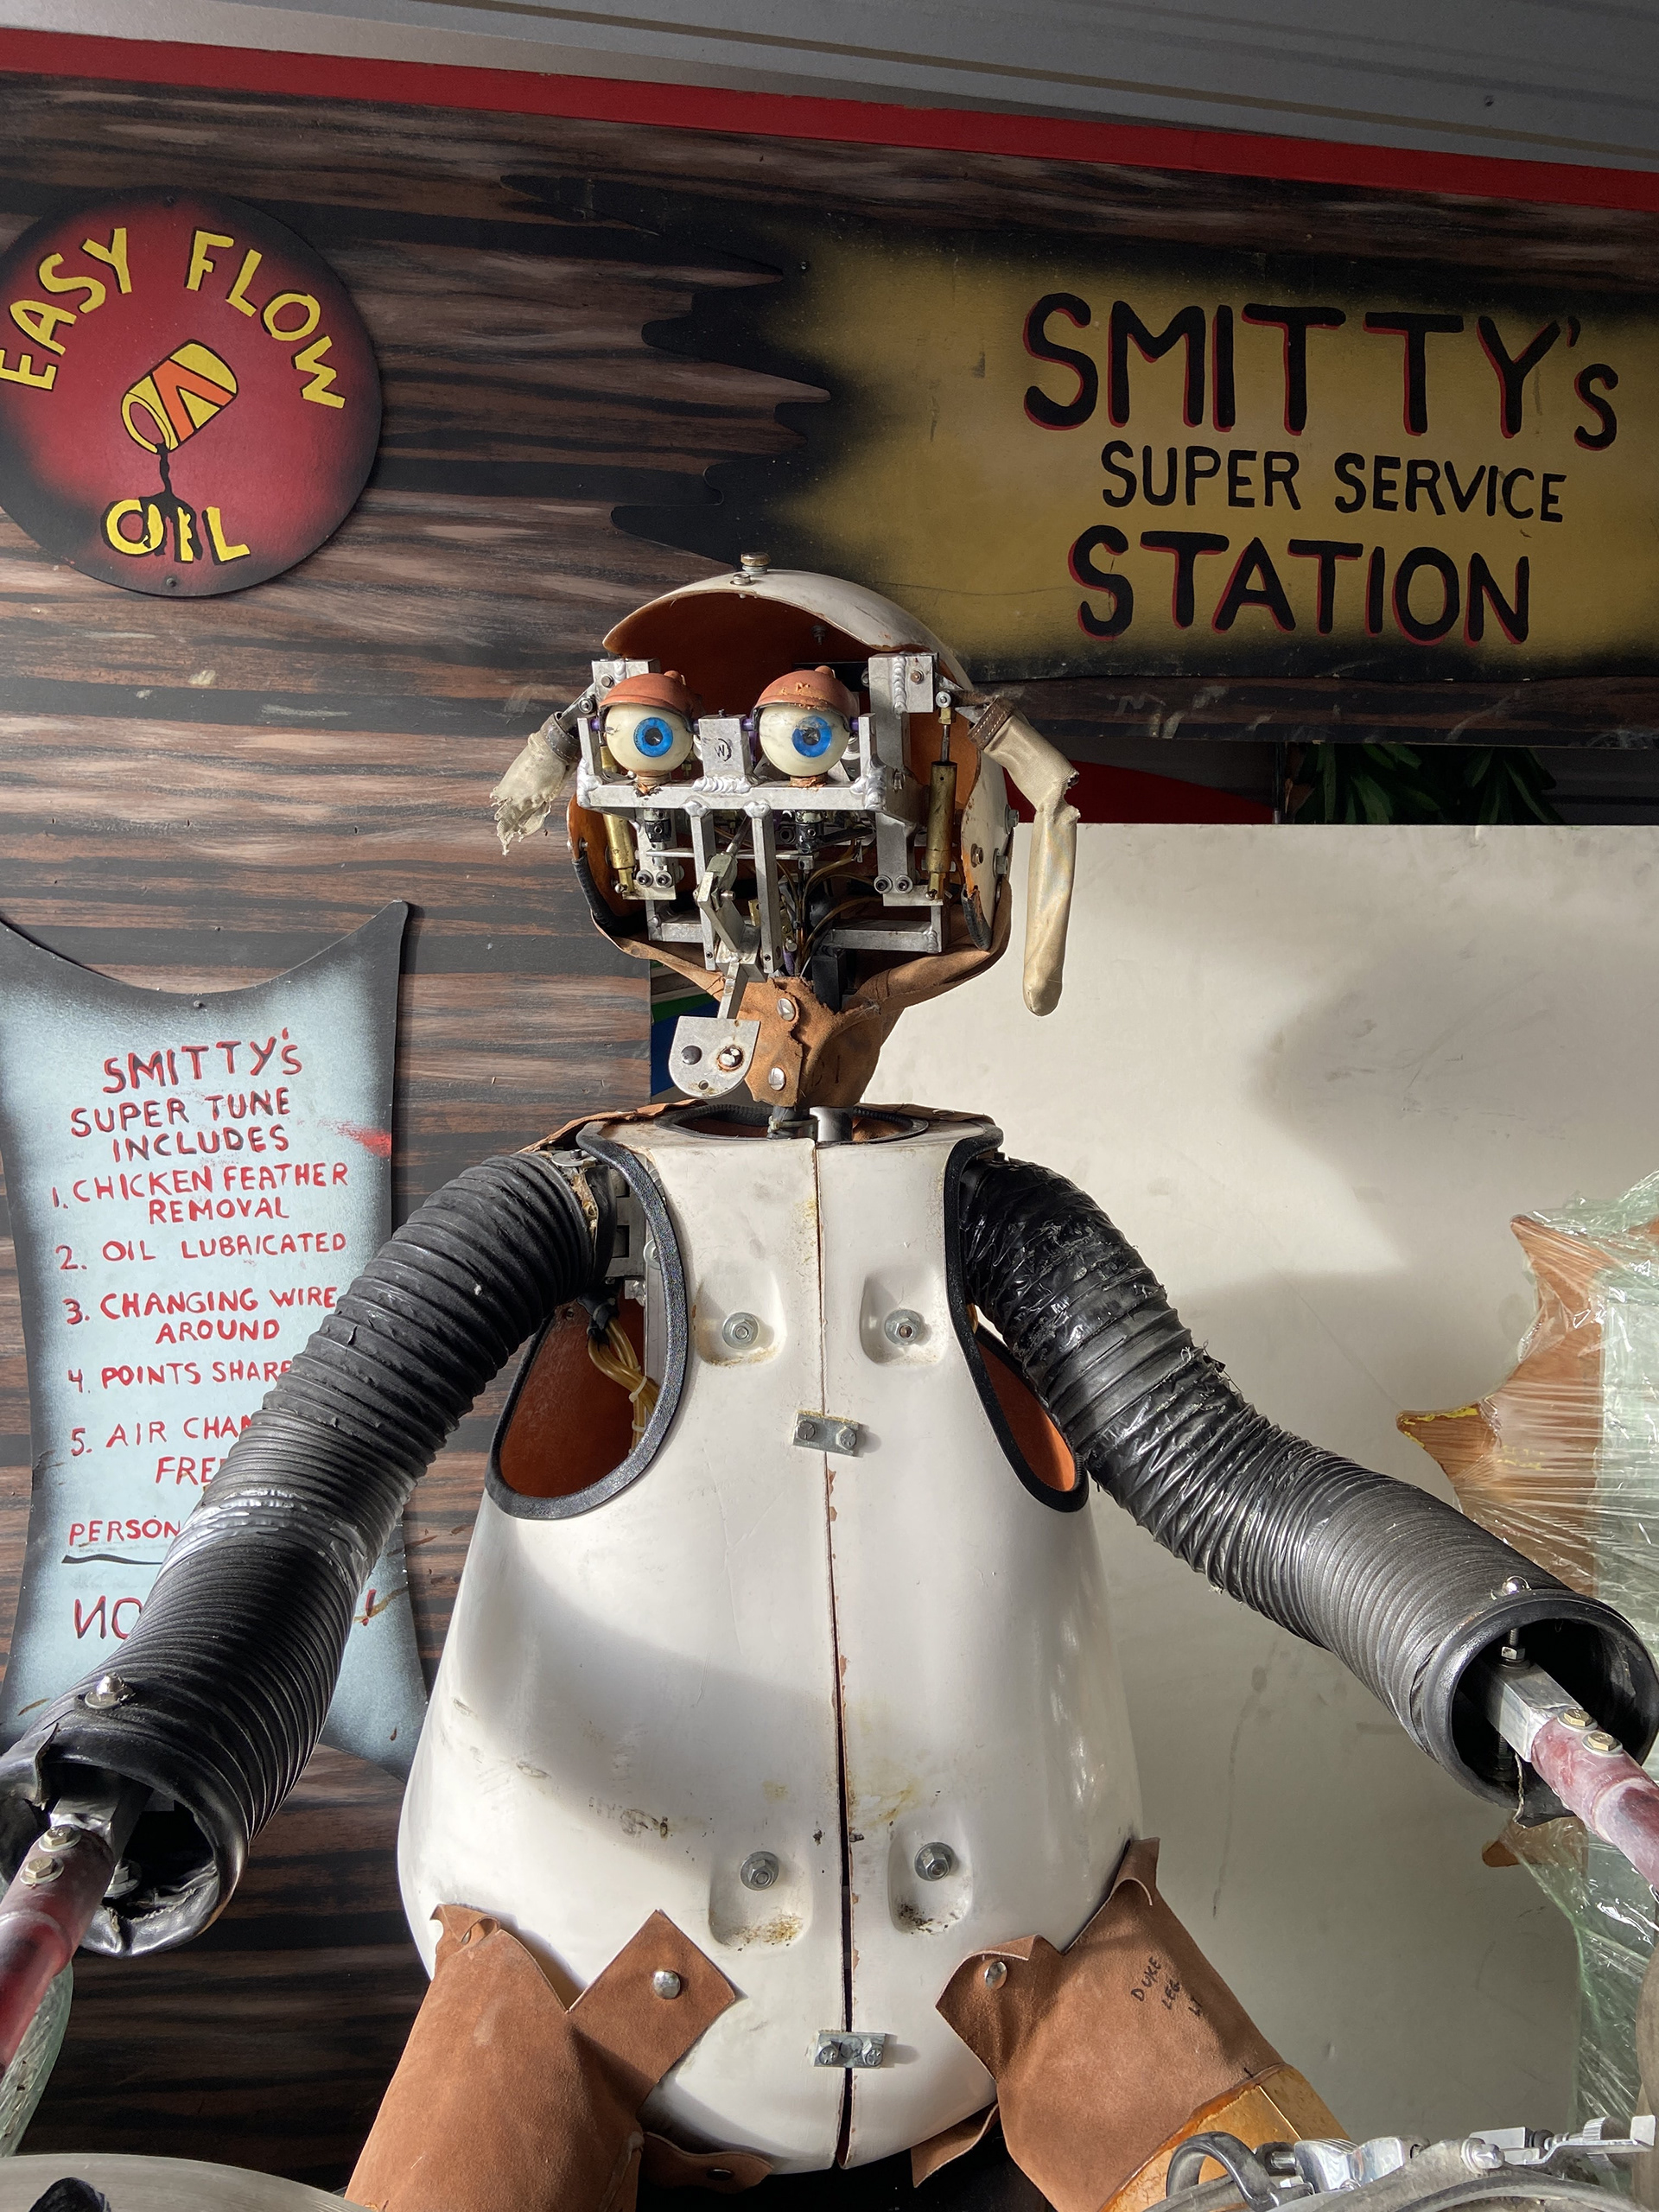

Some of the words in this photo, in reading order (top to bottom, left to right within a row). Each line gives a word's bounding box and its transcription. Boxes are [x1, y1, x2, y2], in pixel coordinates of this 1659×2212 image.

[0, 227, 132, 391] EASY
[185, 229, 346, 409] FLOW
[1101, 440, 1302, 511] SUPER
[1334, 452, 1567, 523] SERVICE
[104, 499, 251, 563] OIL
[1068, 524, 1529, 646] STATION
[71, 1097, 190, 1138] SUPER
[204, 1086, 292, 1121] TUNE
[112, 1123, 290, 1163] INCLUDES
[72, 1164, 213, 1204] CHICKEN
[223, 1162, 349, 1192] FEATHER
[149, 1196, 291, 1225] REMOVAL
[54, 1245, 87, 1270] 2.
[102, 1240, 156, 1262] OIL
[62, 1298, 91, 1325] 3.
[99, 1286, 260, 1319] CHANGING
[269, 1286, 338, 1309] WIRE
[155, 1318, 281, 1344] AROUND
[101, 1361, 202, 1389] POINTS
[70, 1427, 93, 1457] 5.
[105, 1421, 168, 1448] AIR
[1130, 1956, 1162, 2002] DUKE
